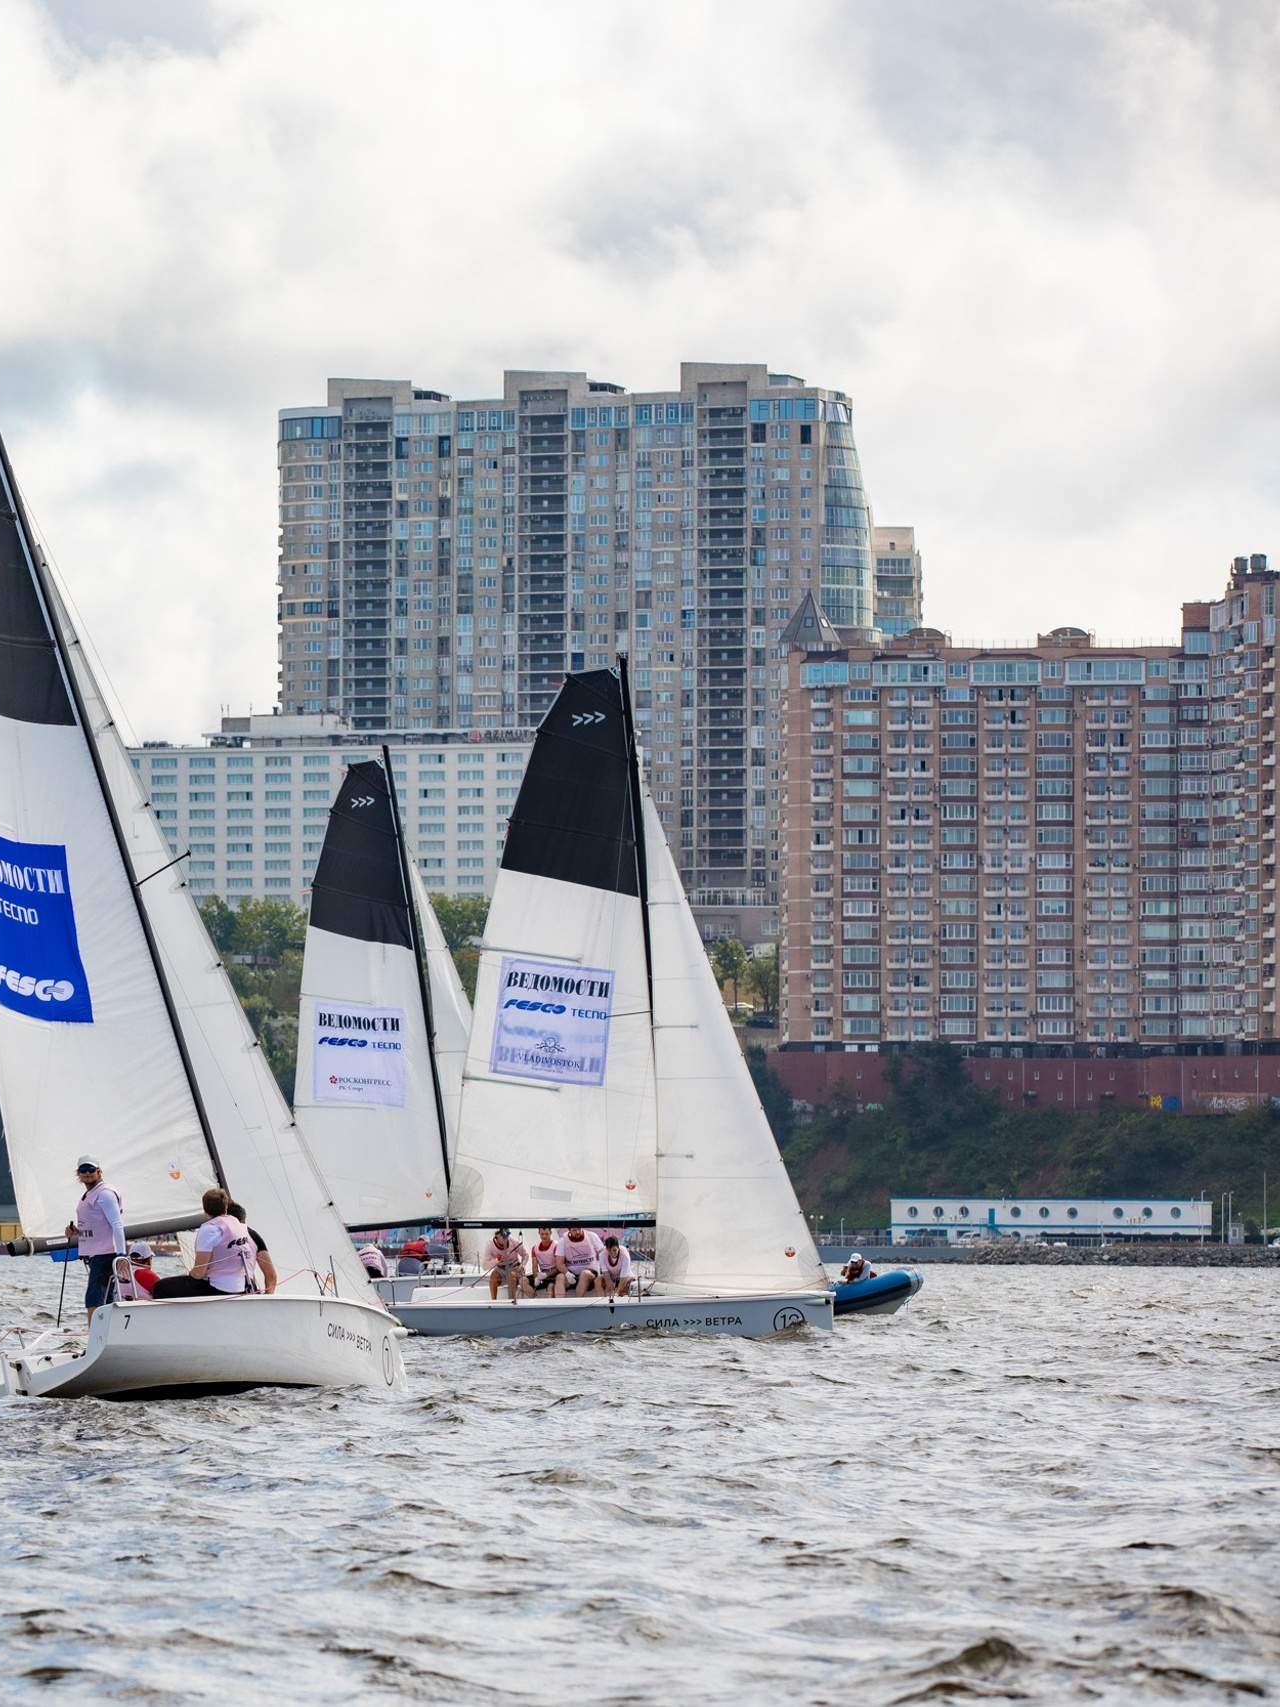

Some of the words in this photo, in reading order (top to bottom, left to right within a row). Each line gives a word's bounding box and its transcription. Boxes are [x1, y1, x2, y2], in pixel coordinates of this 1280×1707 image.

[506, 971, 610, 998] ВЕДОМОСТИ
[503, 999, 567, 1015] FESCO
[571, 1008, 607, 1020] TECNO
[318, 1012, 400, 1032] ВЕДОМОСТИ
[318, 1036, 368, 1048] FESCO
[371, 1041, 401, 1050] TECNO
[517, 1053, 581, 1068] VLADIVOSTOK
[338, 1077, 392, 1086] РОСКОНГРЕСС
[123, 1314, 131, 1329] 7
[646, 1318, 680, 1328] СИЛА
[705, 1316, 743, 1327] ВЕТРА
[327, 1322, 346, 1341] СИЛА
